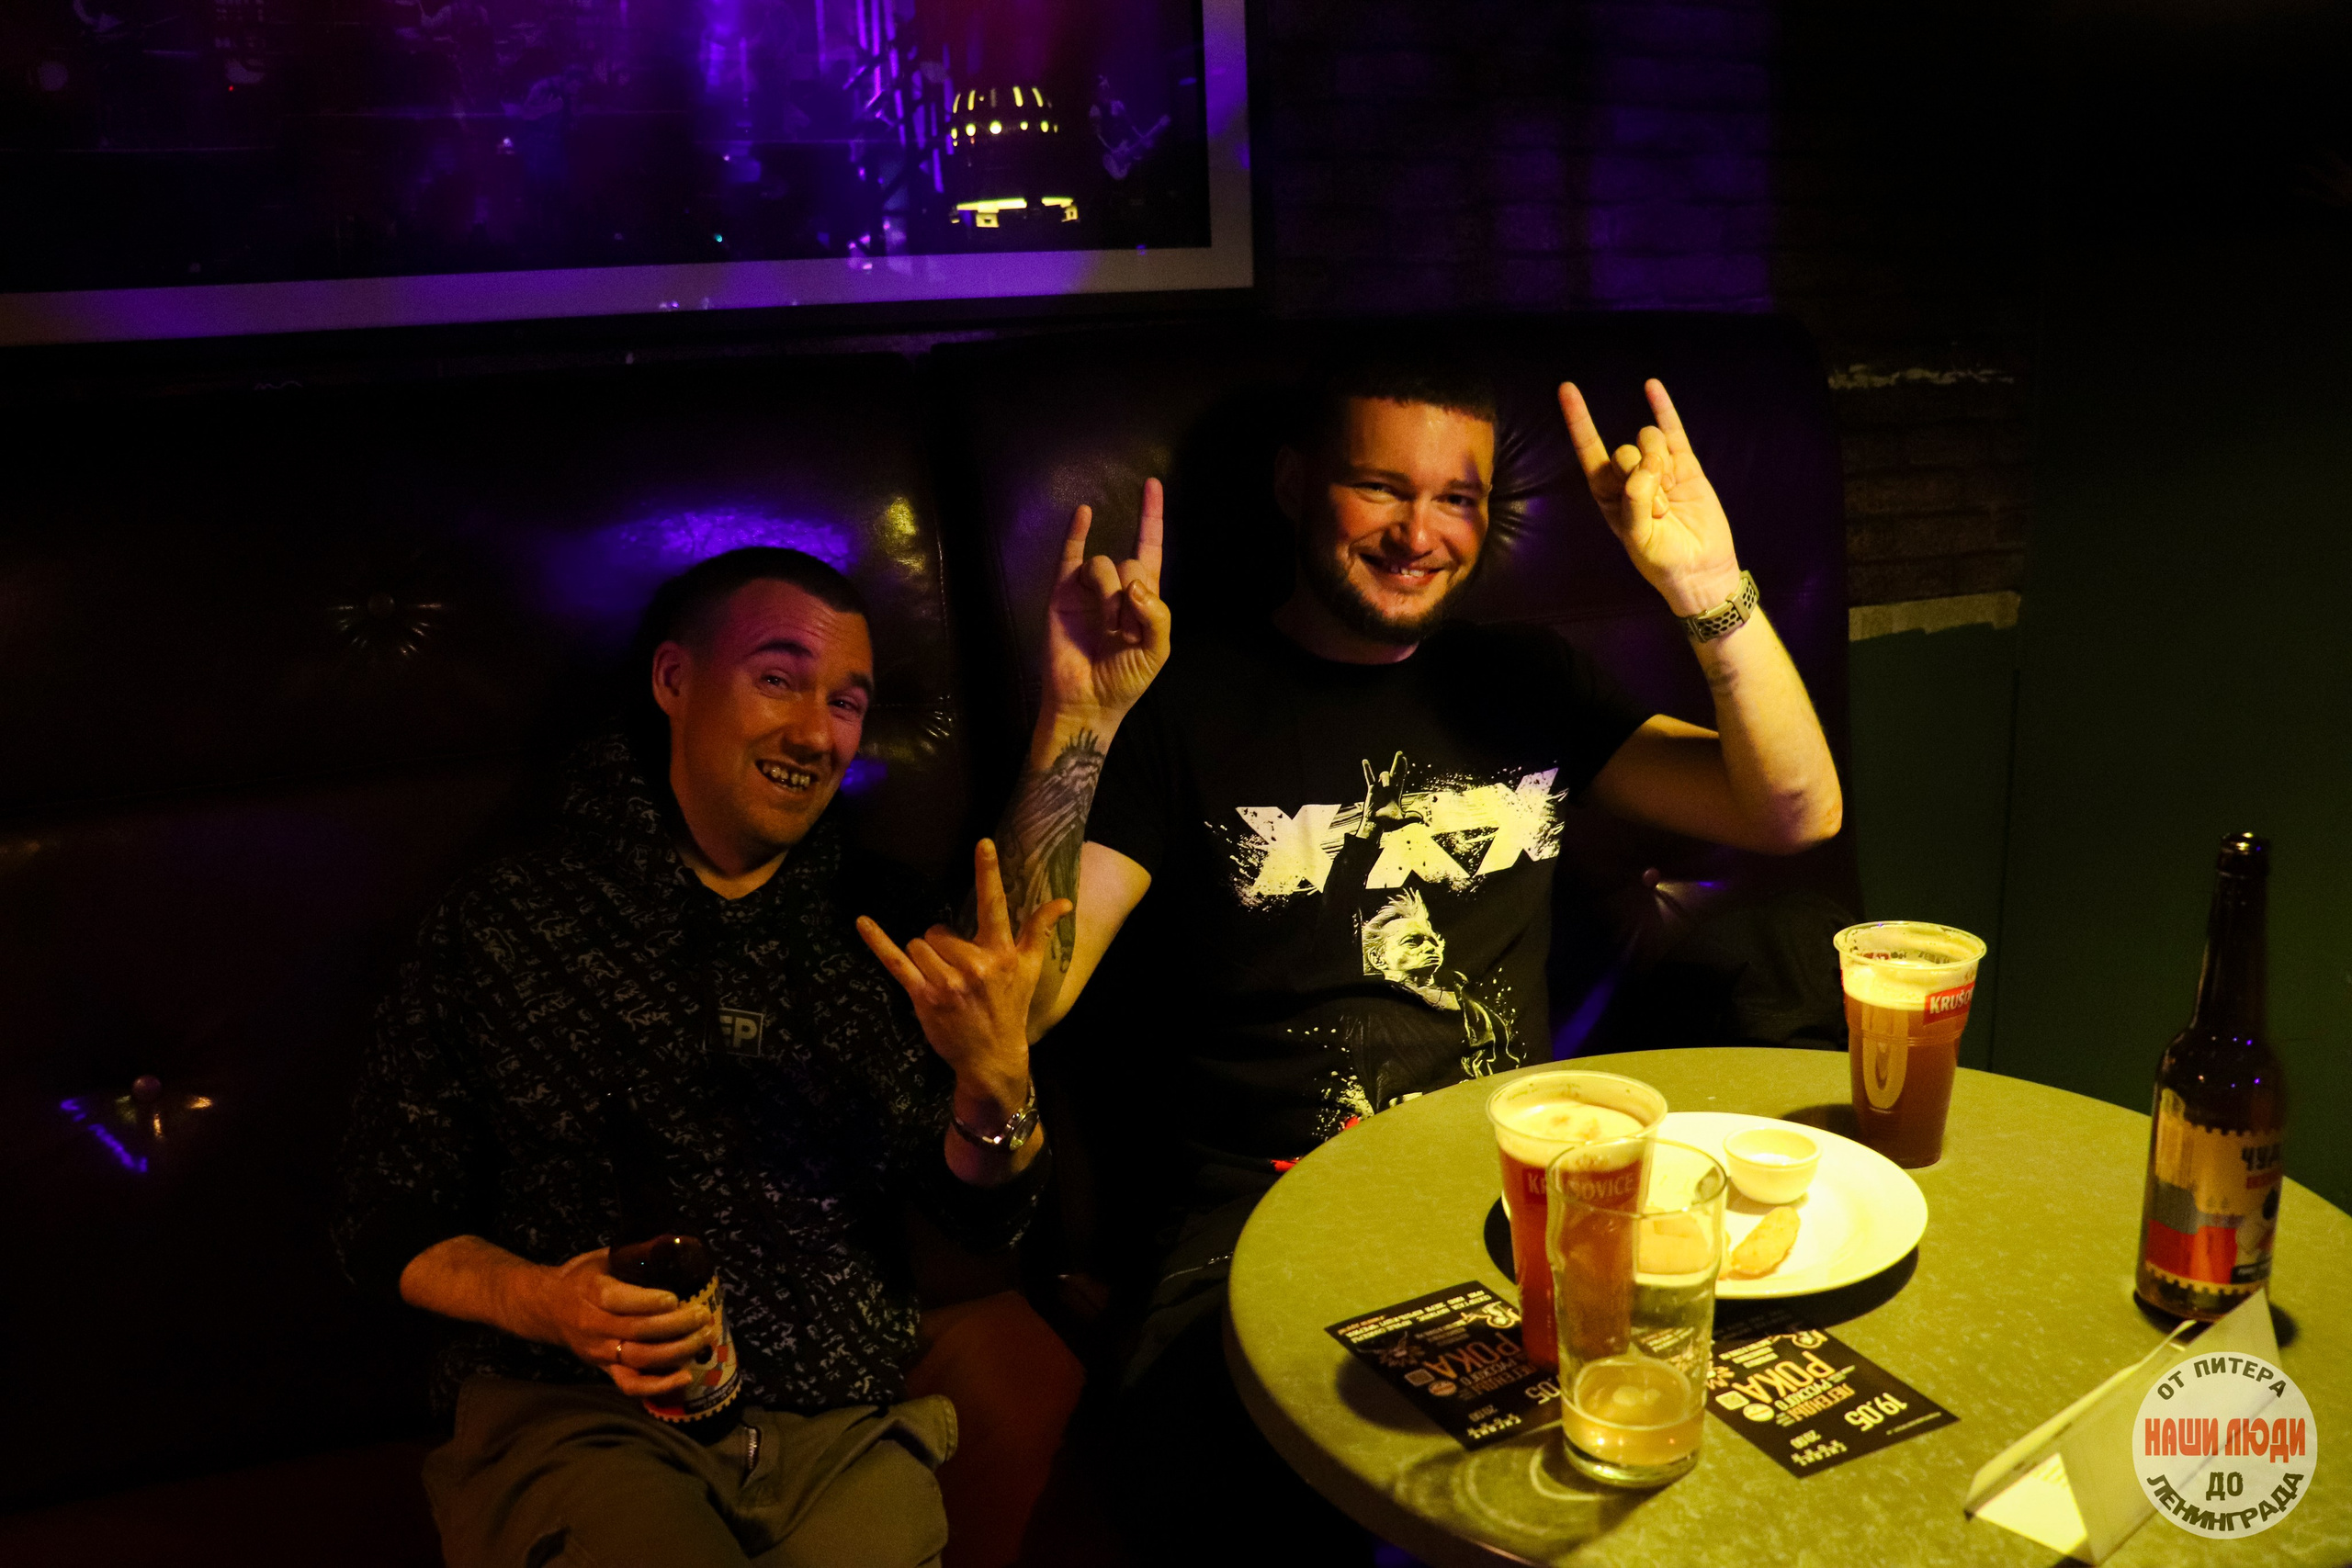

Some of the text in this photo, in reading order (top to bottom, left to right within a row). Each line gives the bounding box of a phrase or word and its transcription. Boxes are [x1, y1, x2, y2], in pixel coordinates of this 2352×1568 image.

[1423, 1332, 1522, 1379] РОКА
[1732, 1350, 1836, 1404] РОКА
[1774, 1379, 1833, 1412] РУССКОГО
[1788, 1382, 1856, 1422] ЛЕГЕНДЫ
[1844, 1392, 1908, 1432] 19.05
